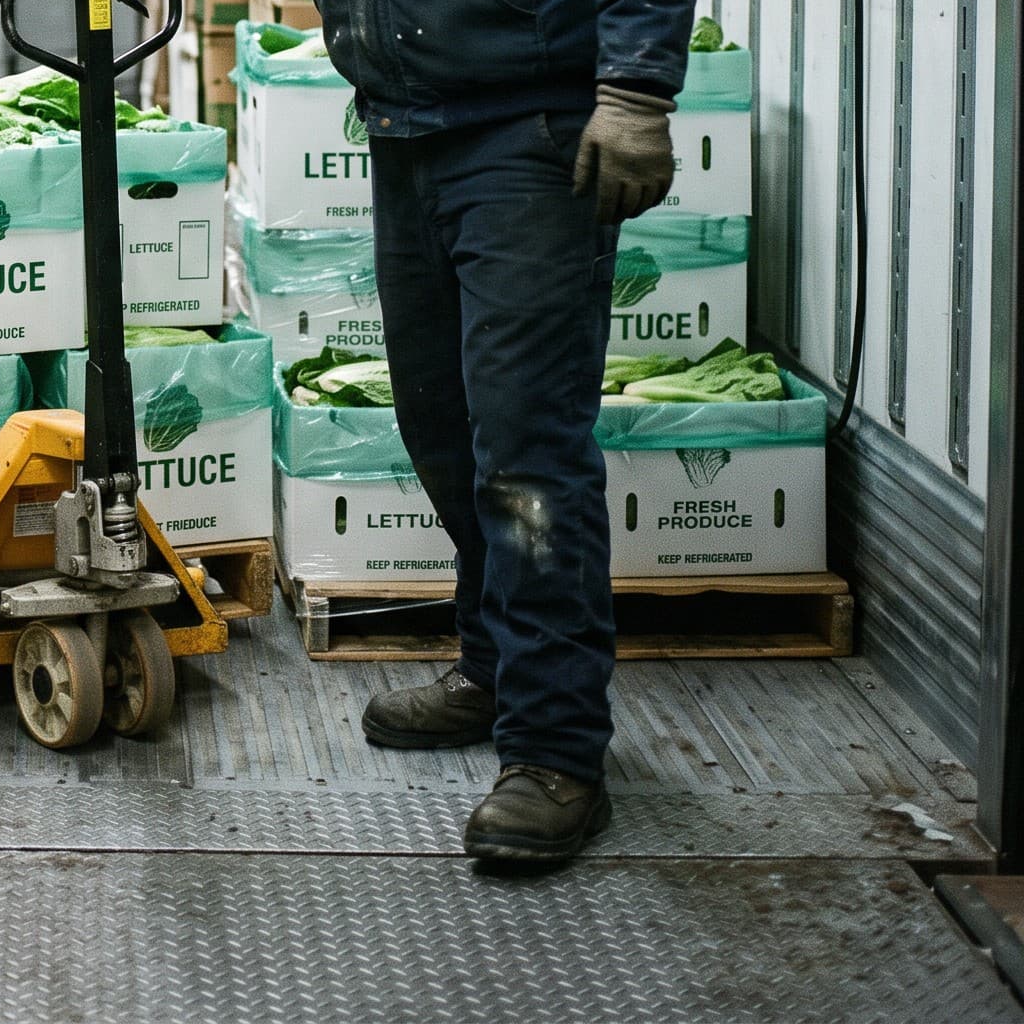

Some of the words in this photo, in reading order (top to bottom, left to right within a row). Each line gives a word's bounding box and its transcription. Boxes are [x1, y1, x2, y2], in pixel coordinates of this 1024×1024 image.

[304, 152, 370, 179] LETT
[326, 206, 358, 217] FRESH
[129, 242, 174, 254] LETTUCE
[130, 300, 200, 313] REFRIGERATED
[338, 320, 382, 332] FRES
[610, 312, 692, 340] TUCE
[326, 334, 385, 346] PRODU
[138, 453, 236, 491] TTUCE
[673, 500, 736, 514] FRESH
[166, 516, 217, 532] FRIEDUCE
[367, 513, 445, 529] LETTUC
[658, 514, 753, 530] PRODUCE
[393, 560, 456, 570] REFRIGERATE
[658, 554, 682, 565] KEEP
[684, 552, 753, 564] REFRIGERATED
